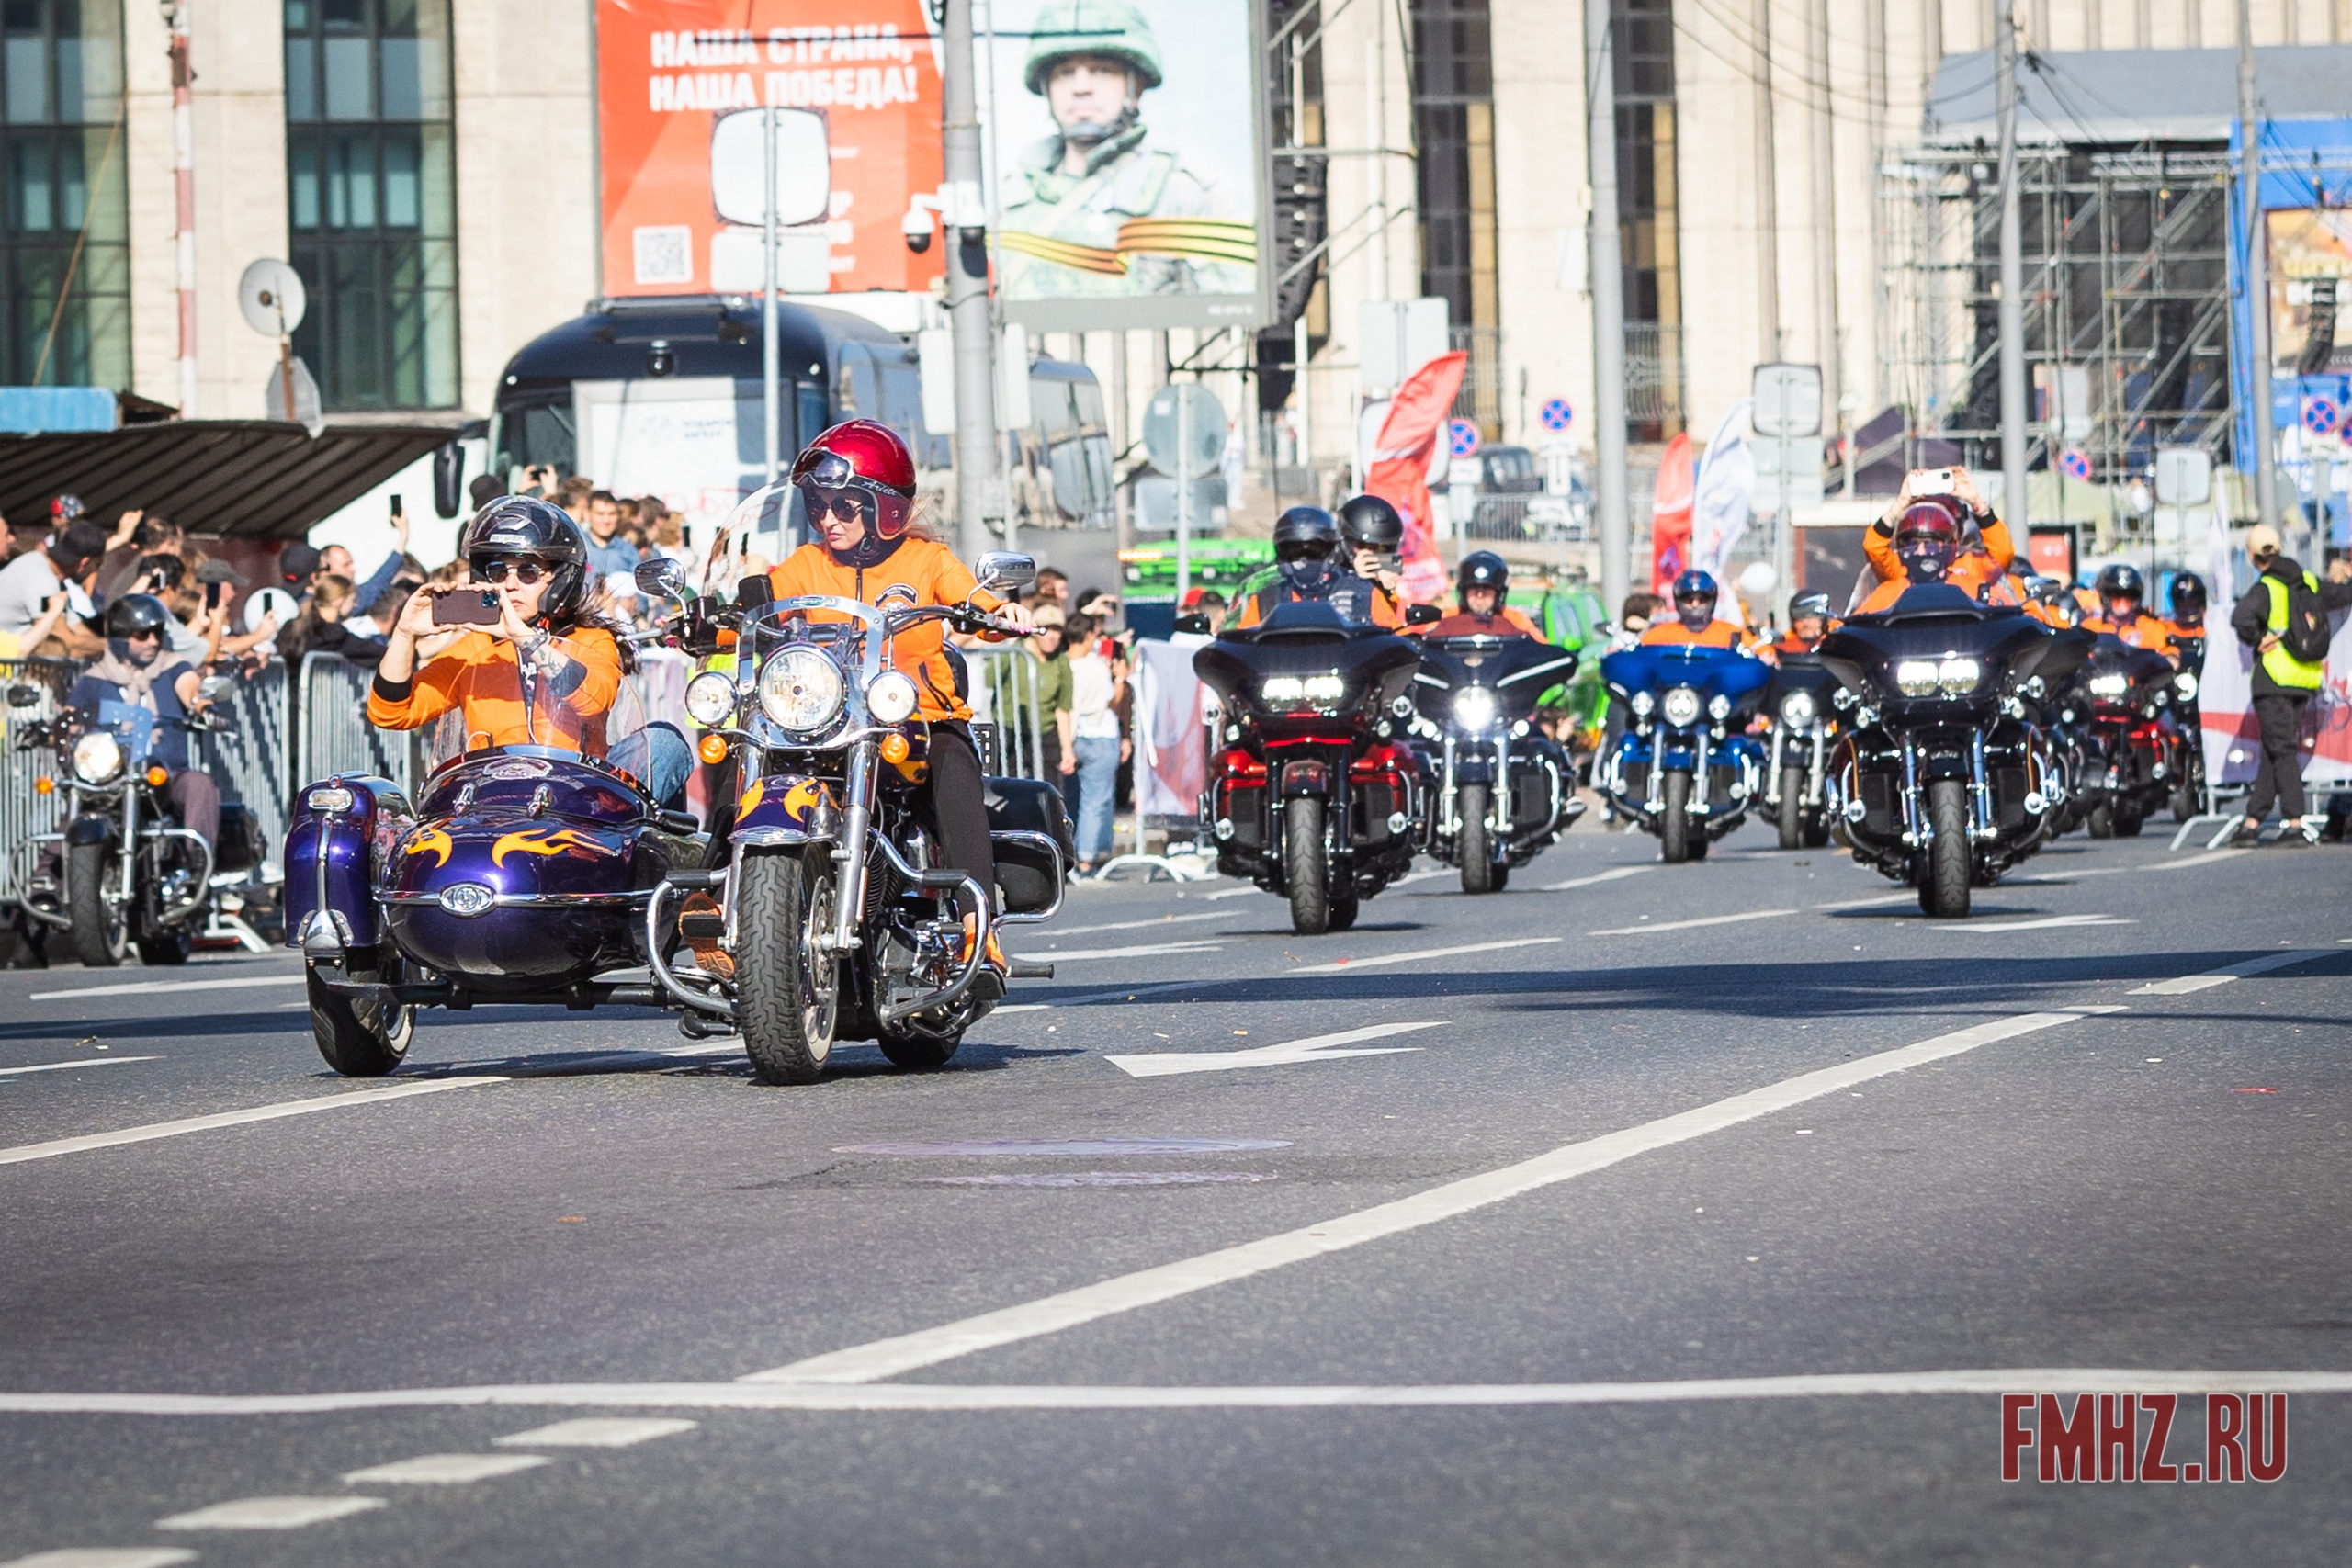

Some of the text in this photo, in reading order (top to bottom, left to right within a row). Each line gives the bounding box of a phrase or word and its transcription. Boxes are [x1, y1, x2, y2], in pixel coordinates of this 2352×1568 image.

[650, 23, 914, 68] НАША СТРАНА,
[649, 65, 919, 112] НАША ПОБЕДА!
